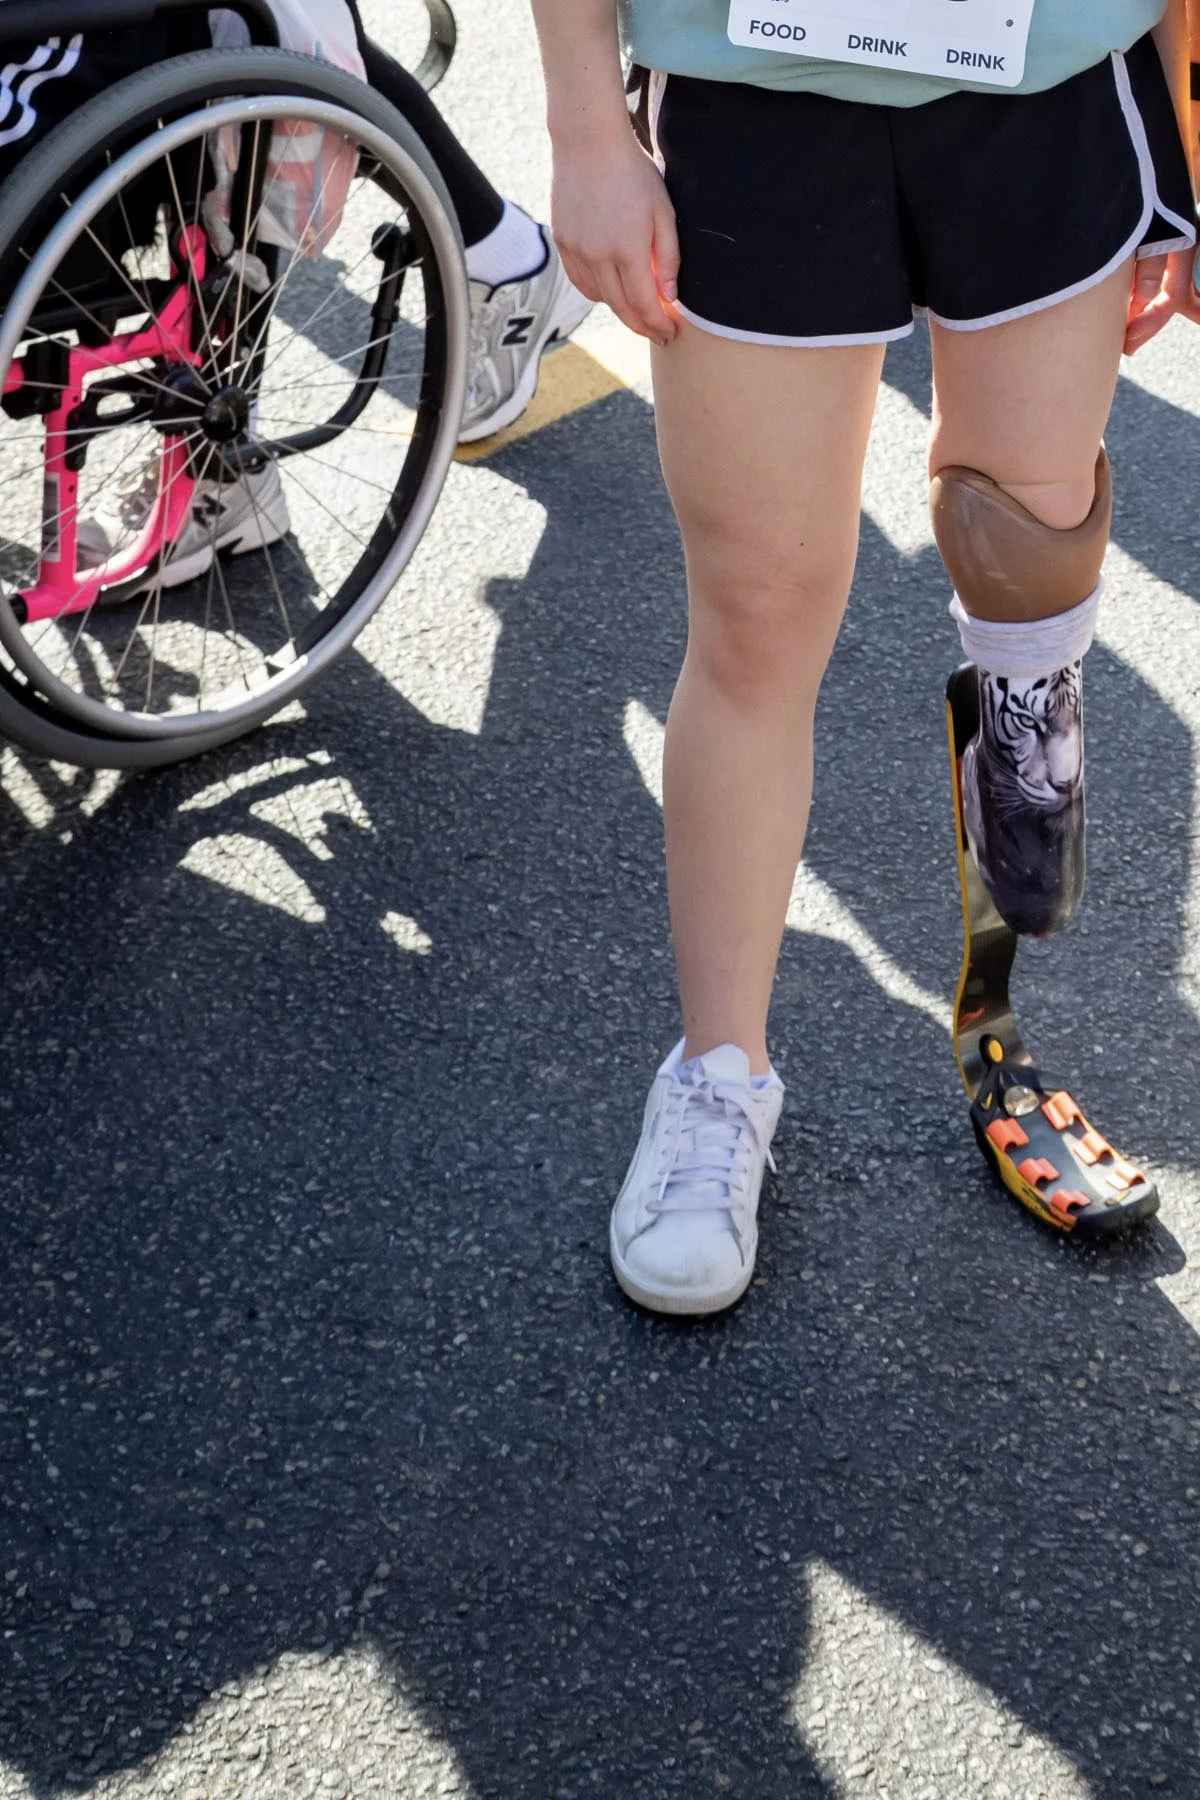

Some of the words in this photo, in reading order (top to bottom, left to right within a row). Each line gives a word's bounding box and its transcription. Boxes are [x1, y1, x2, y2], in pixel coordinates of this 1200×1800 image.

[749, 20, 806, 41] FOOD
[848, 34, 908, 57] DRINK
[946, 48, 1005, 71] DRINK
